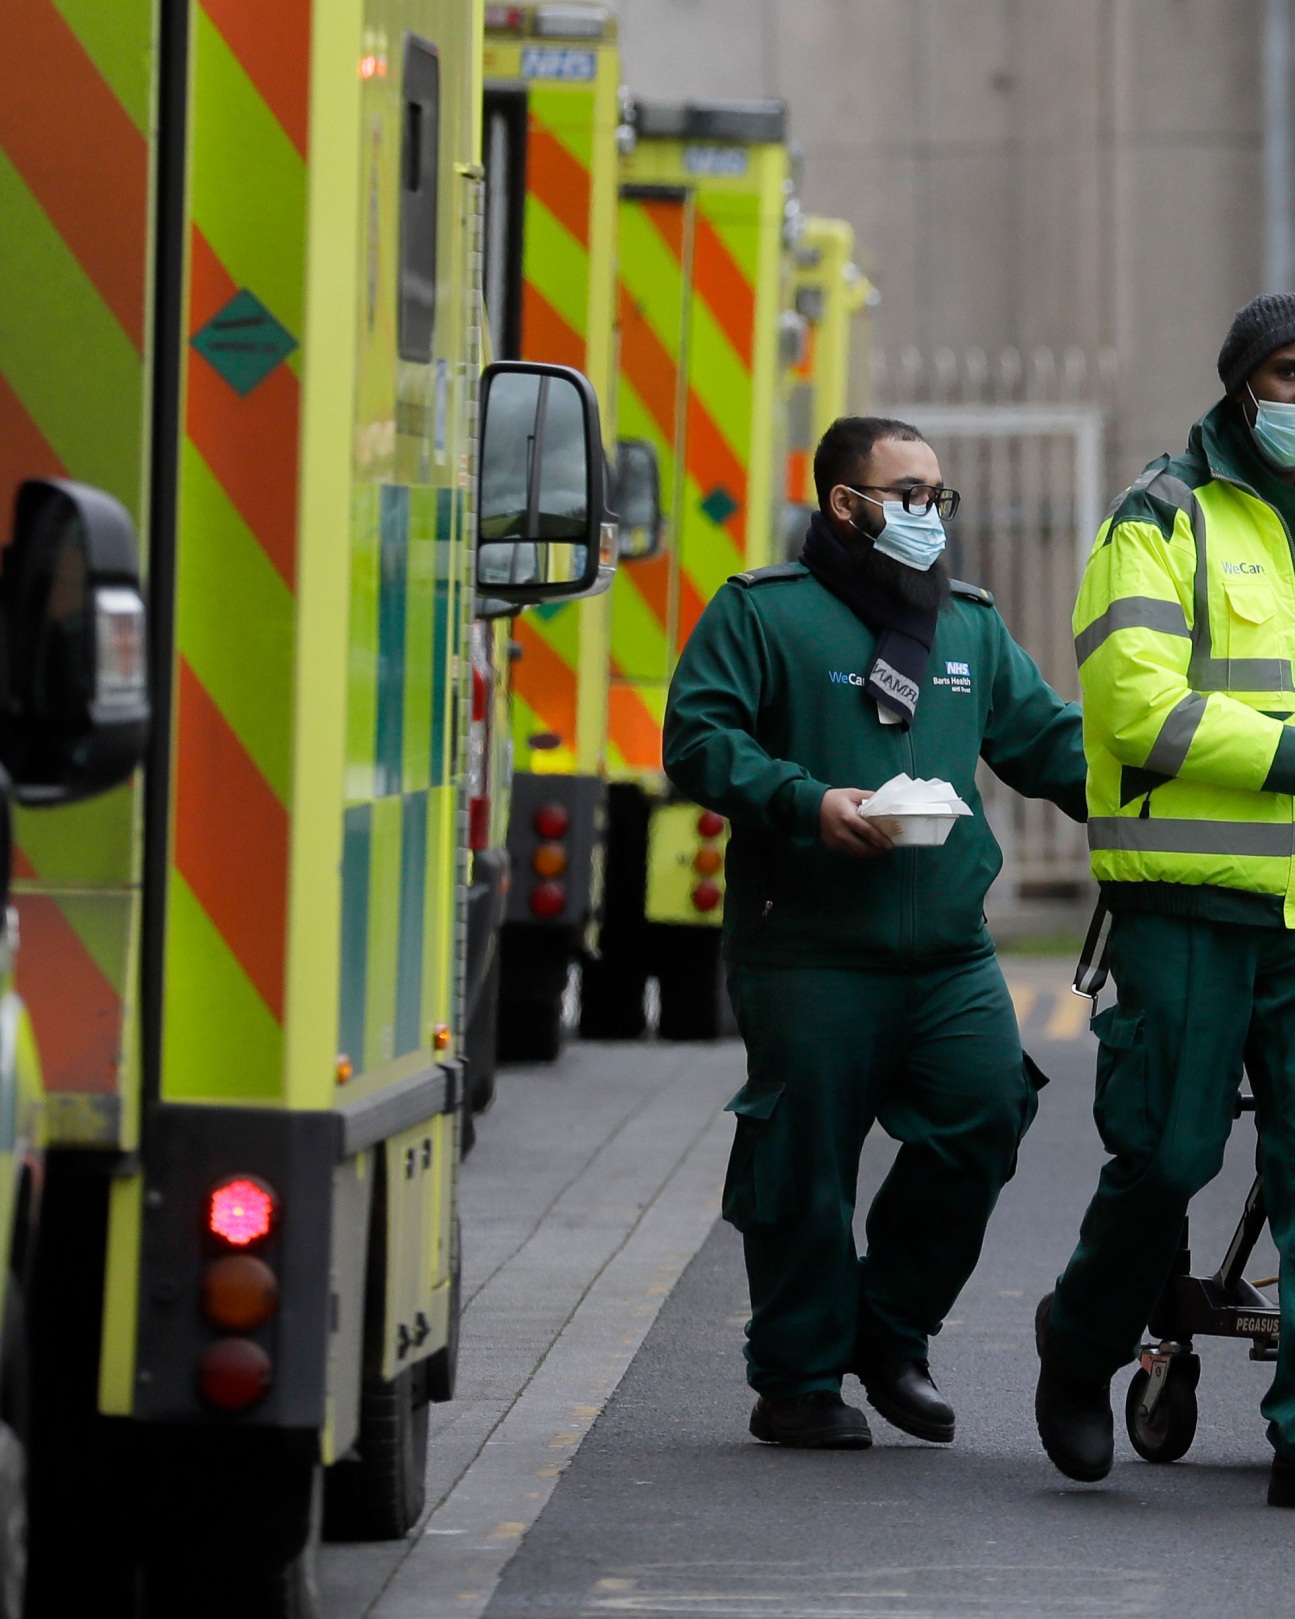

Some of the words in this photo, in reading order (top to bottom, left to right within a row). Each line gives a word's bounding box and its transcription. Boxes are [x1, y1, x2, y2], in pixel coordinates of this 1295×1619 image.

[947, 661, 969, 675] NHS
[933, 676, 950, 685] Barts
[951, 677, 971, 686] Health
[1236, 1317, 1280, 1332] PEGASUS
